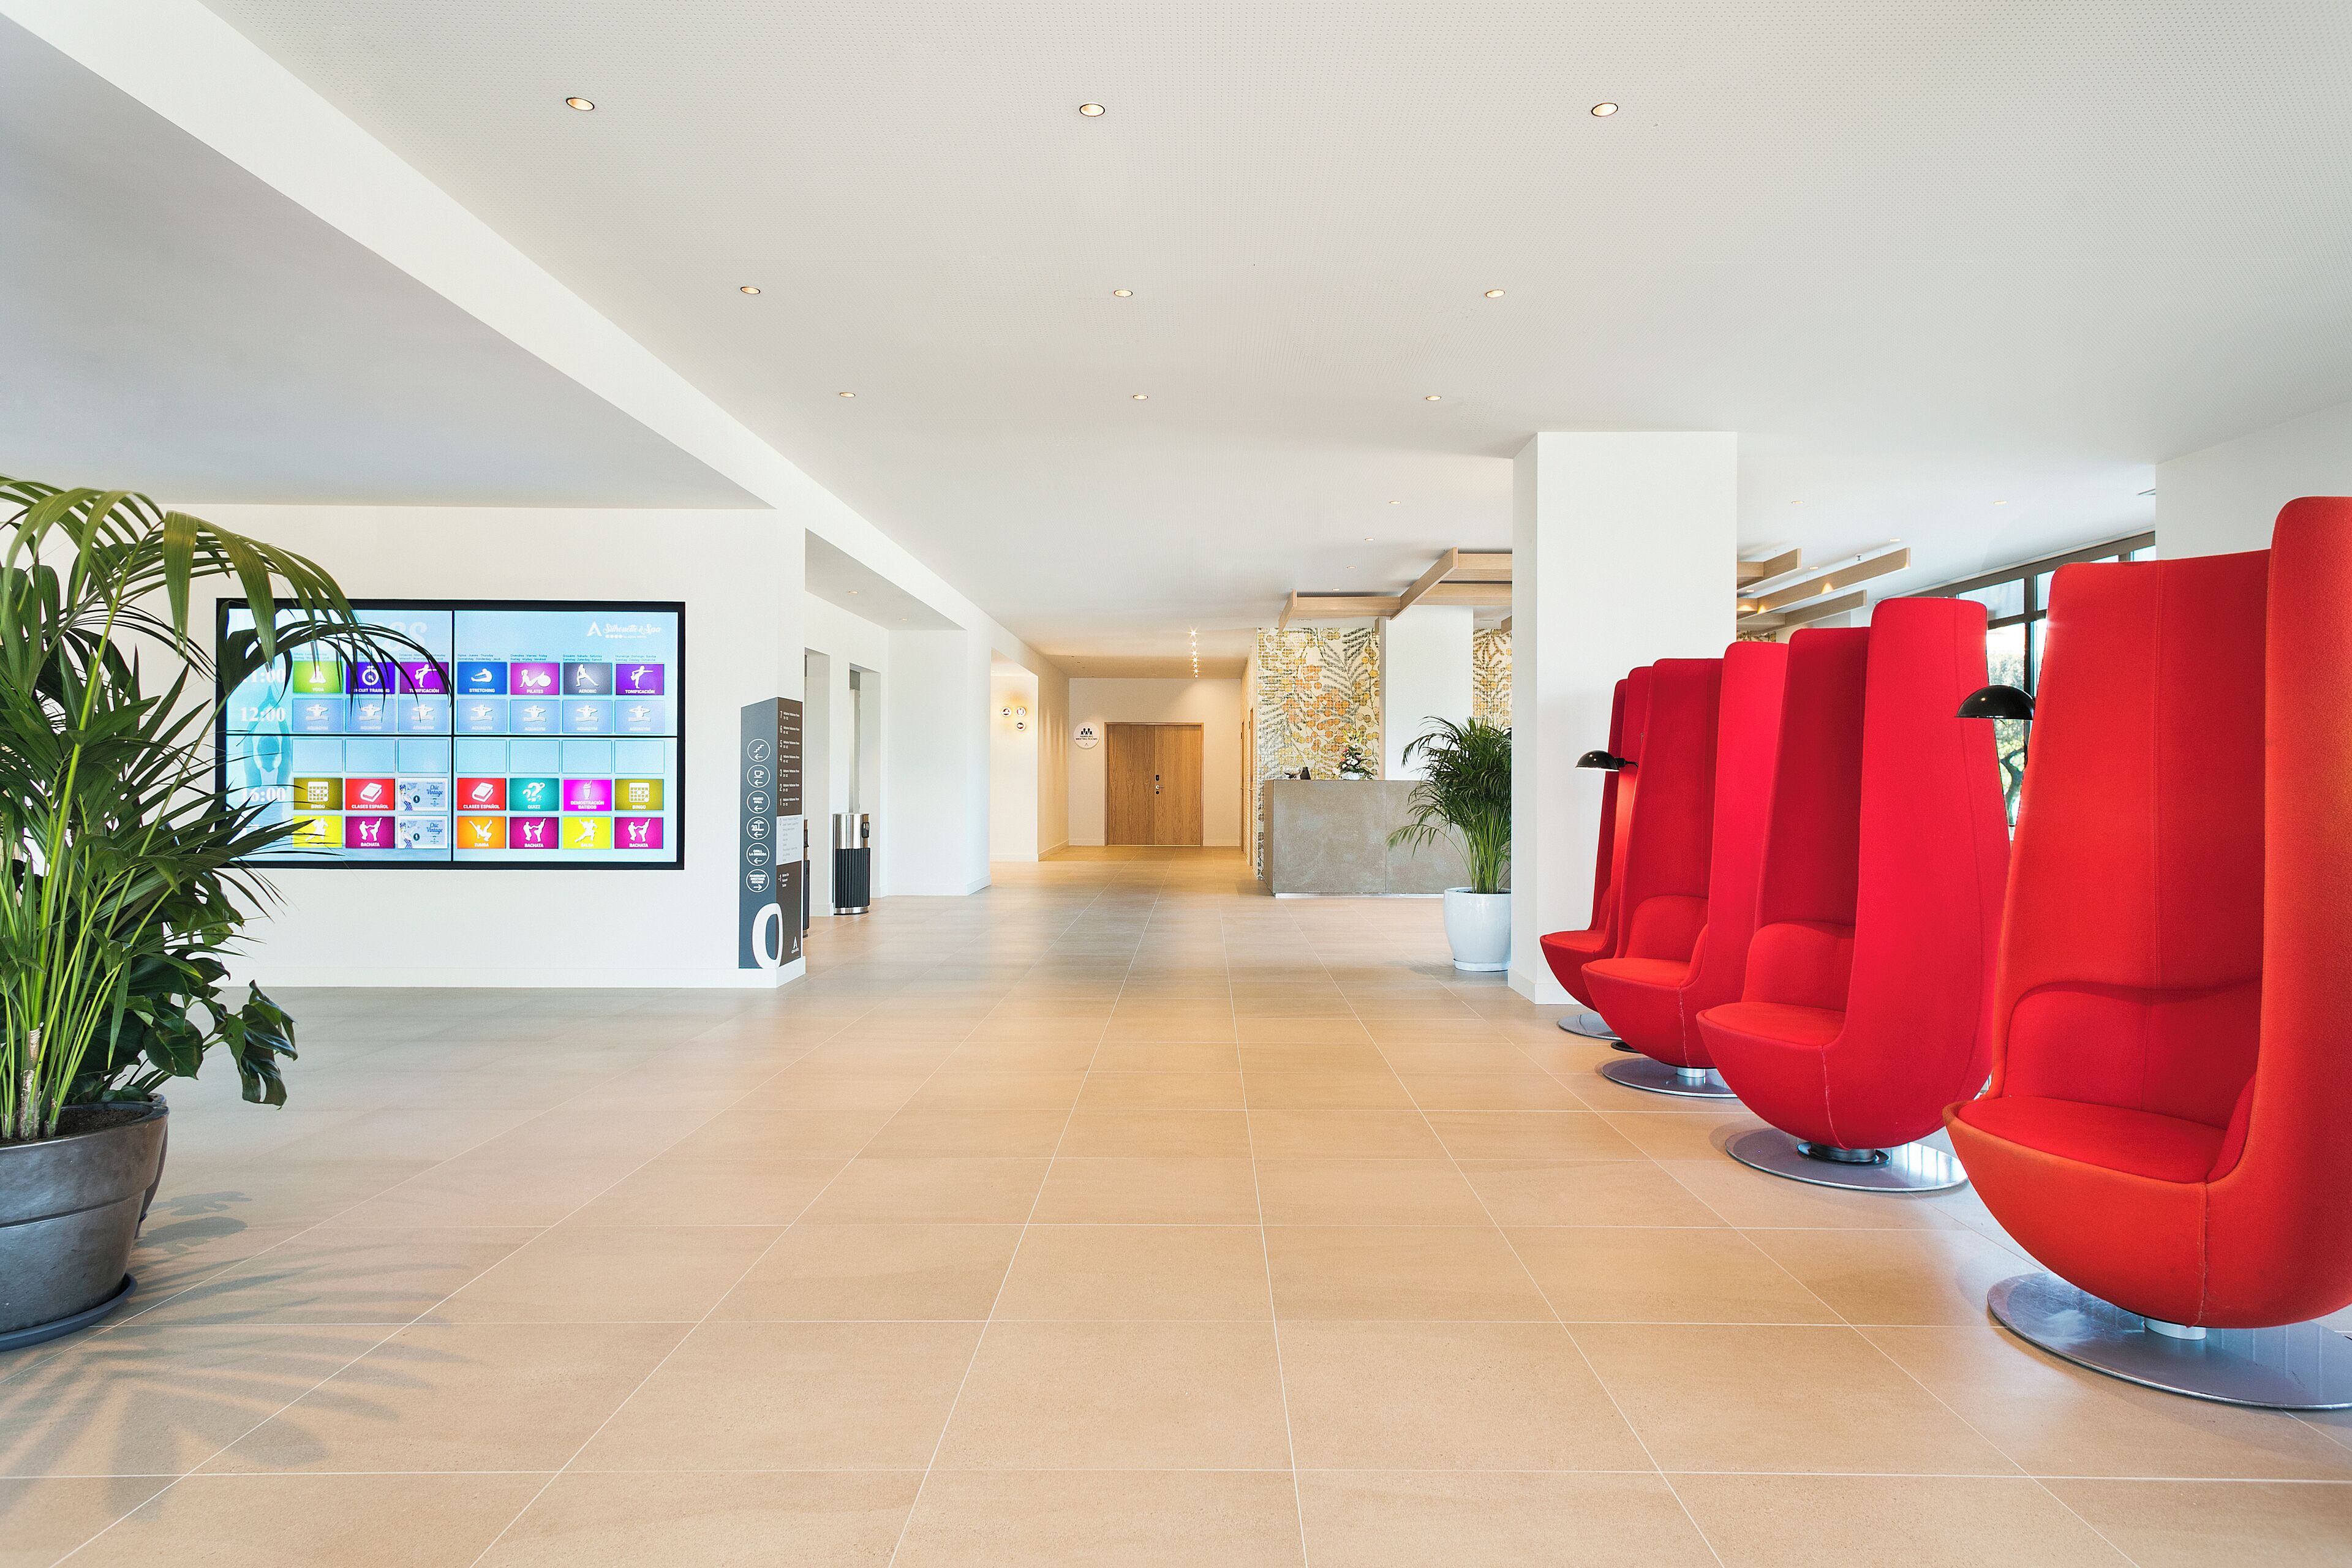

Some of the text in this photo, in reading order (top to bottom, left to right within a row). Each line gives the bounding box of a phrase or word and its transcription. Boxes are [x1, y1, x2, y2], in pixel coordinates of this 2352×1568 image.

[644, 624, 661, 635] Spa
[241, 707, 286, 722] 12:00
[780, 710, 783, 719] 7
[779, 769, 782, 777] 3
[779, 783, 782, 792] 2
[752, 902, 783, 968] 0
